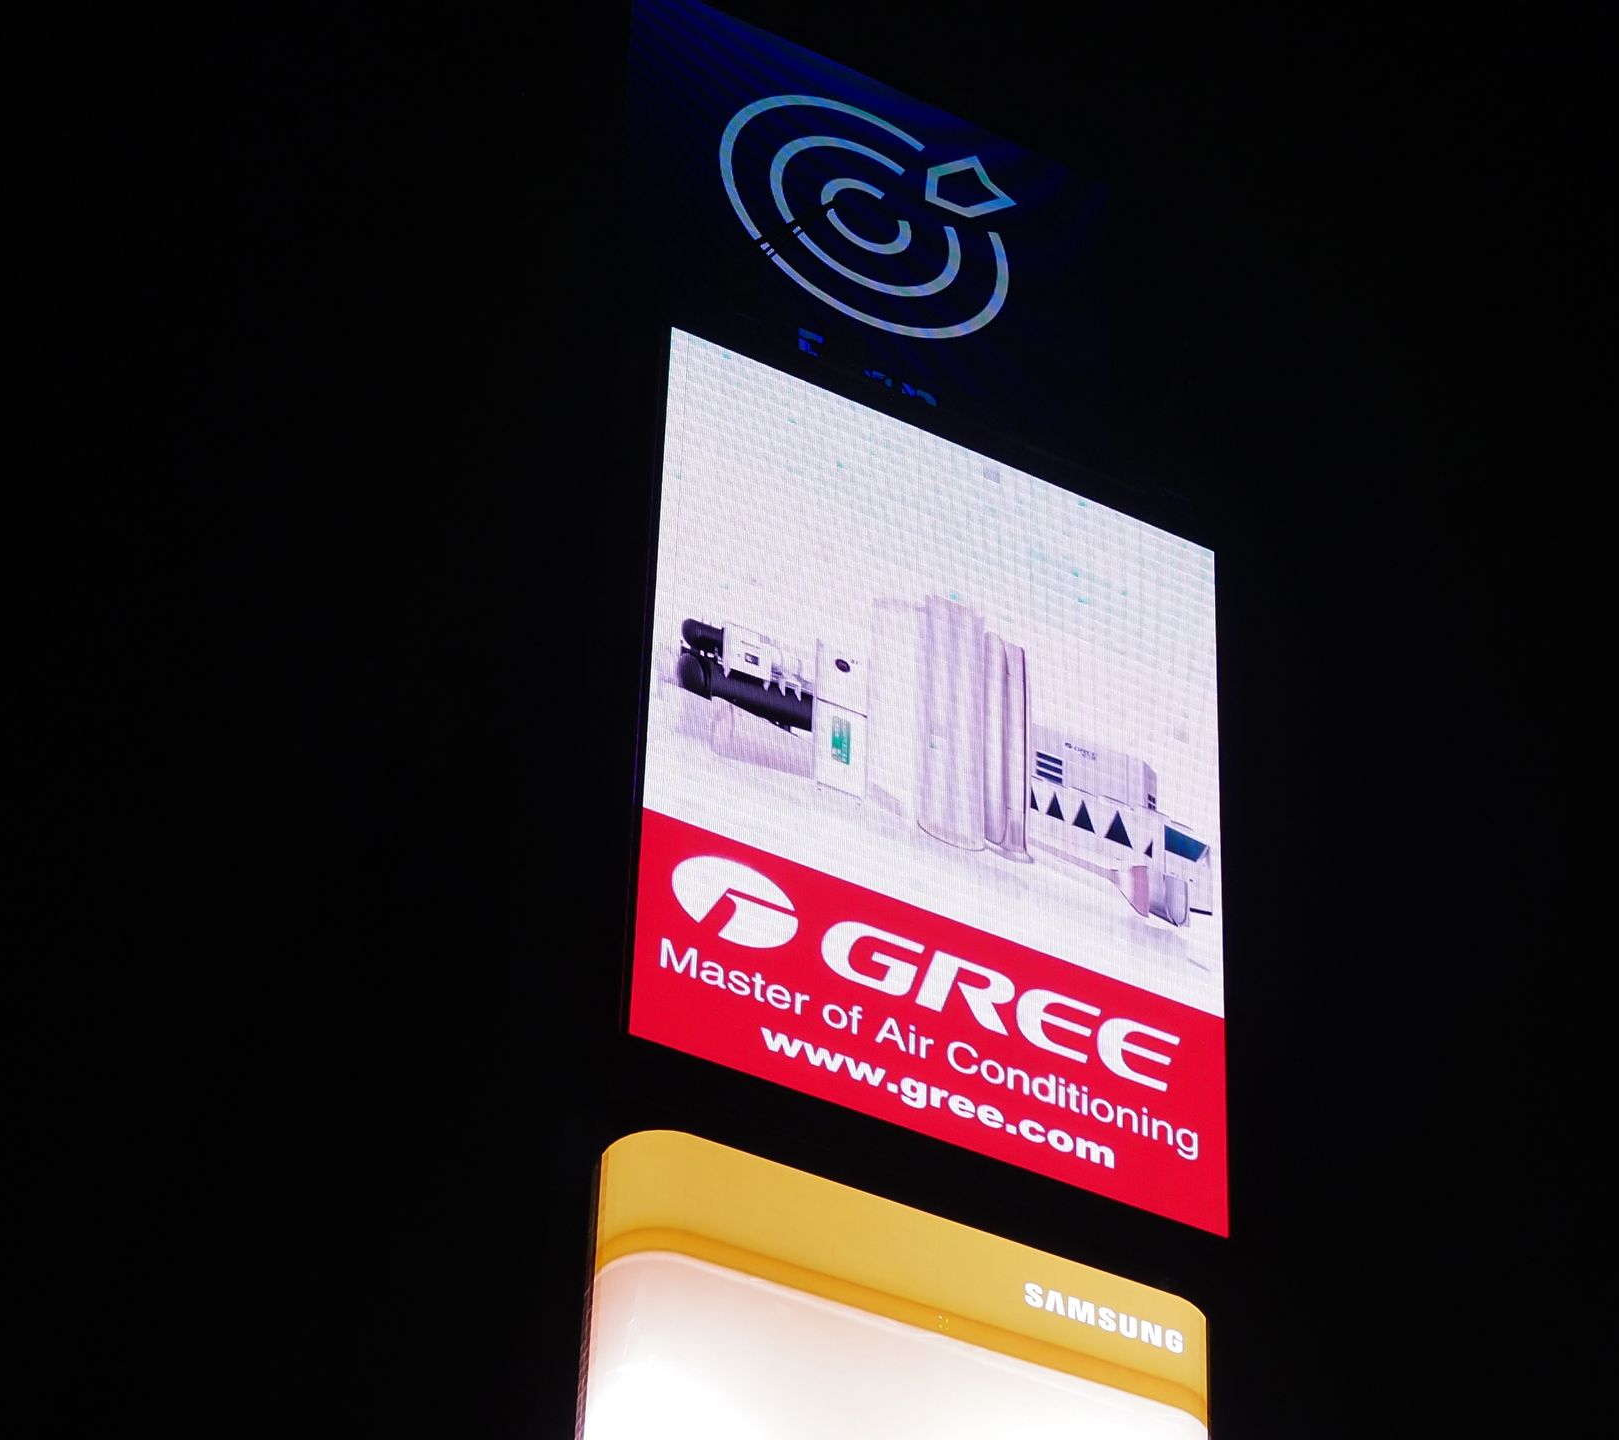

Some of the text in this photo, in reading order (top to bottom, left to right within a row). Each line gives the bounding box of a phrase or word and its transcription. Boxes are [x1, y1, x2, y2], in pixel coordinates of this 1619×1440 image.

[660, 937, 1199, 1161] Master of Air Conditioning
[821, 920, 1180, 1093] GREE
[761, 1027, 1116, 1169] www.gree.com
[1024, 1282, 1184, 1354] SAMSUNG
